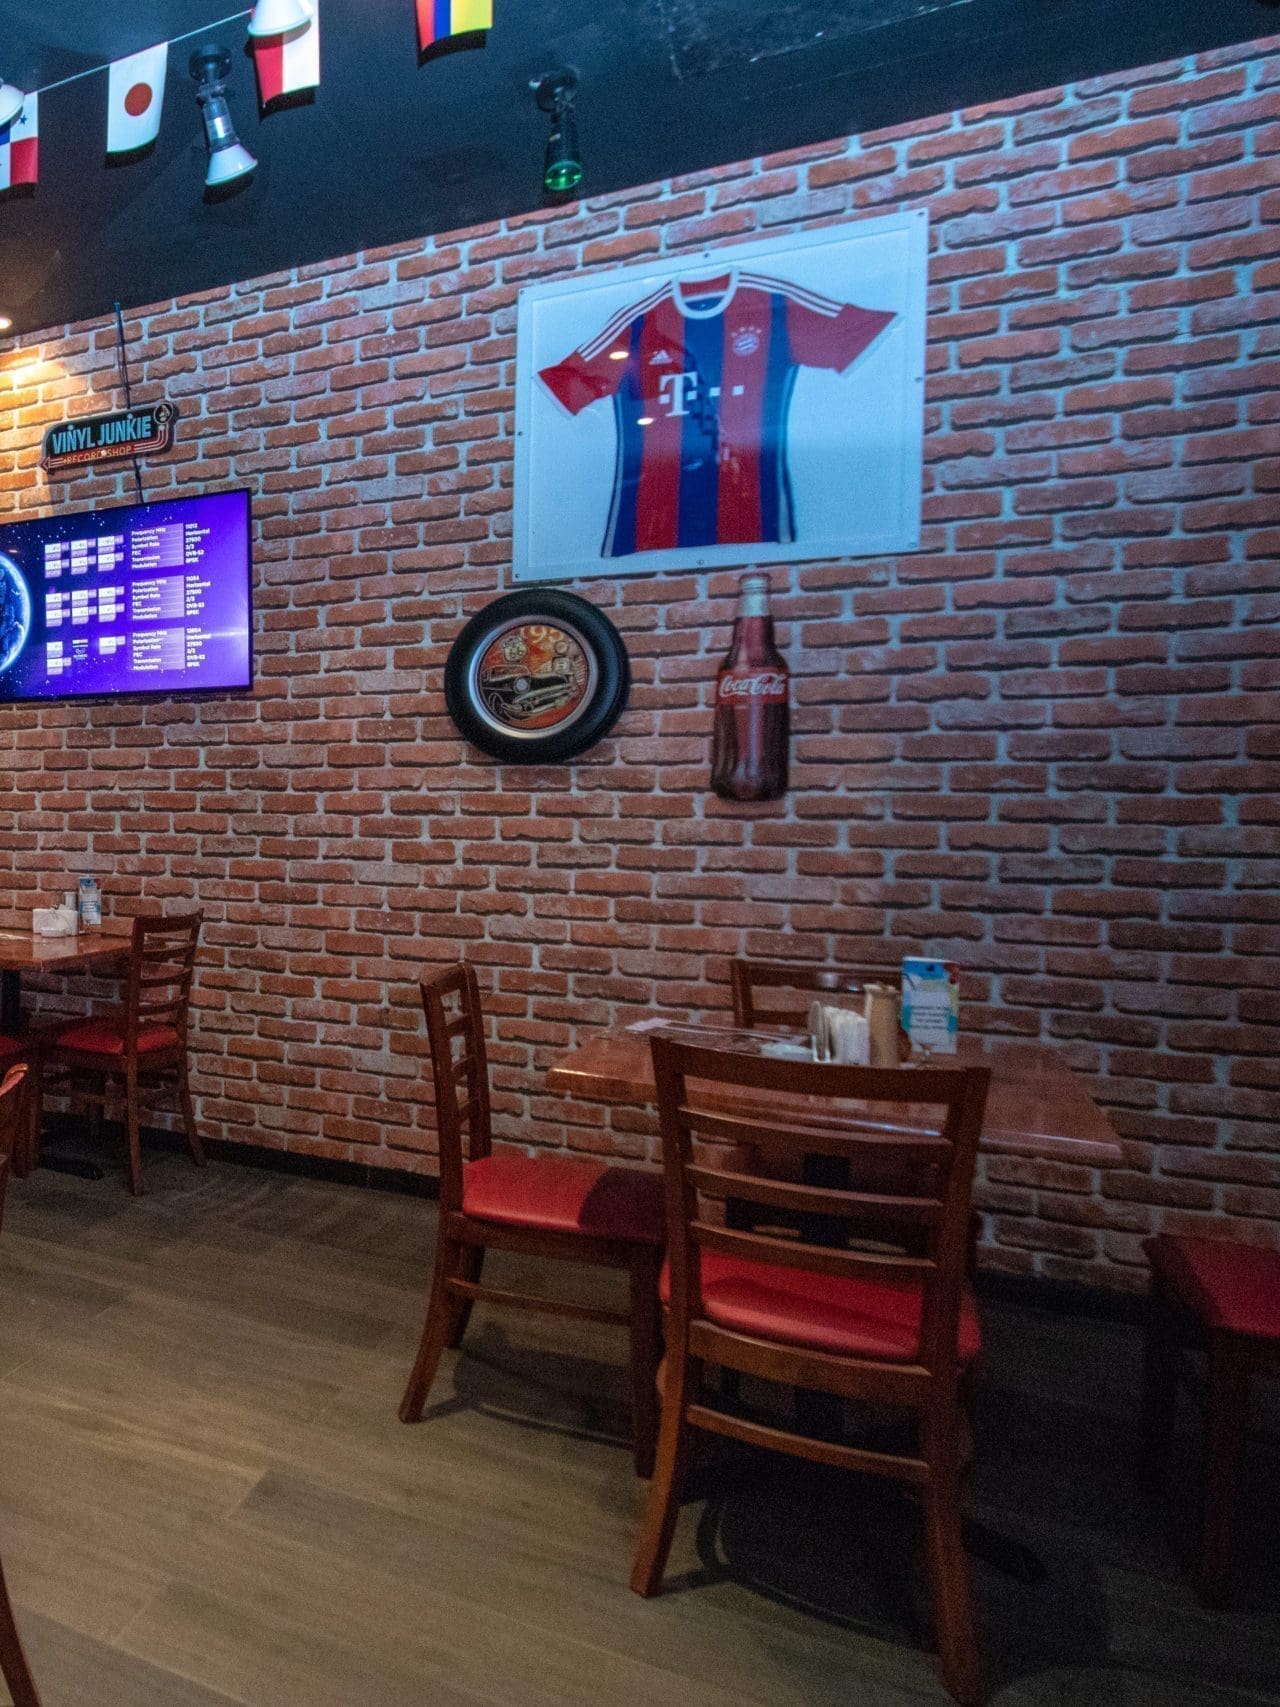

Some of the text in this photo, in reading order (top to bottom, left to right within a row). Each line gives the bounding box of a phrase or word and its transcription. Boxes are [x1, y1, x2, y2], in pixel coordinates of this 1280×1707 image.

[52, 413, 151, 454] VINYL JUNKIE
[107, 445, 132, 457] SHOP
